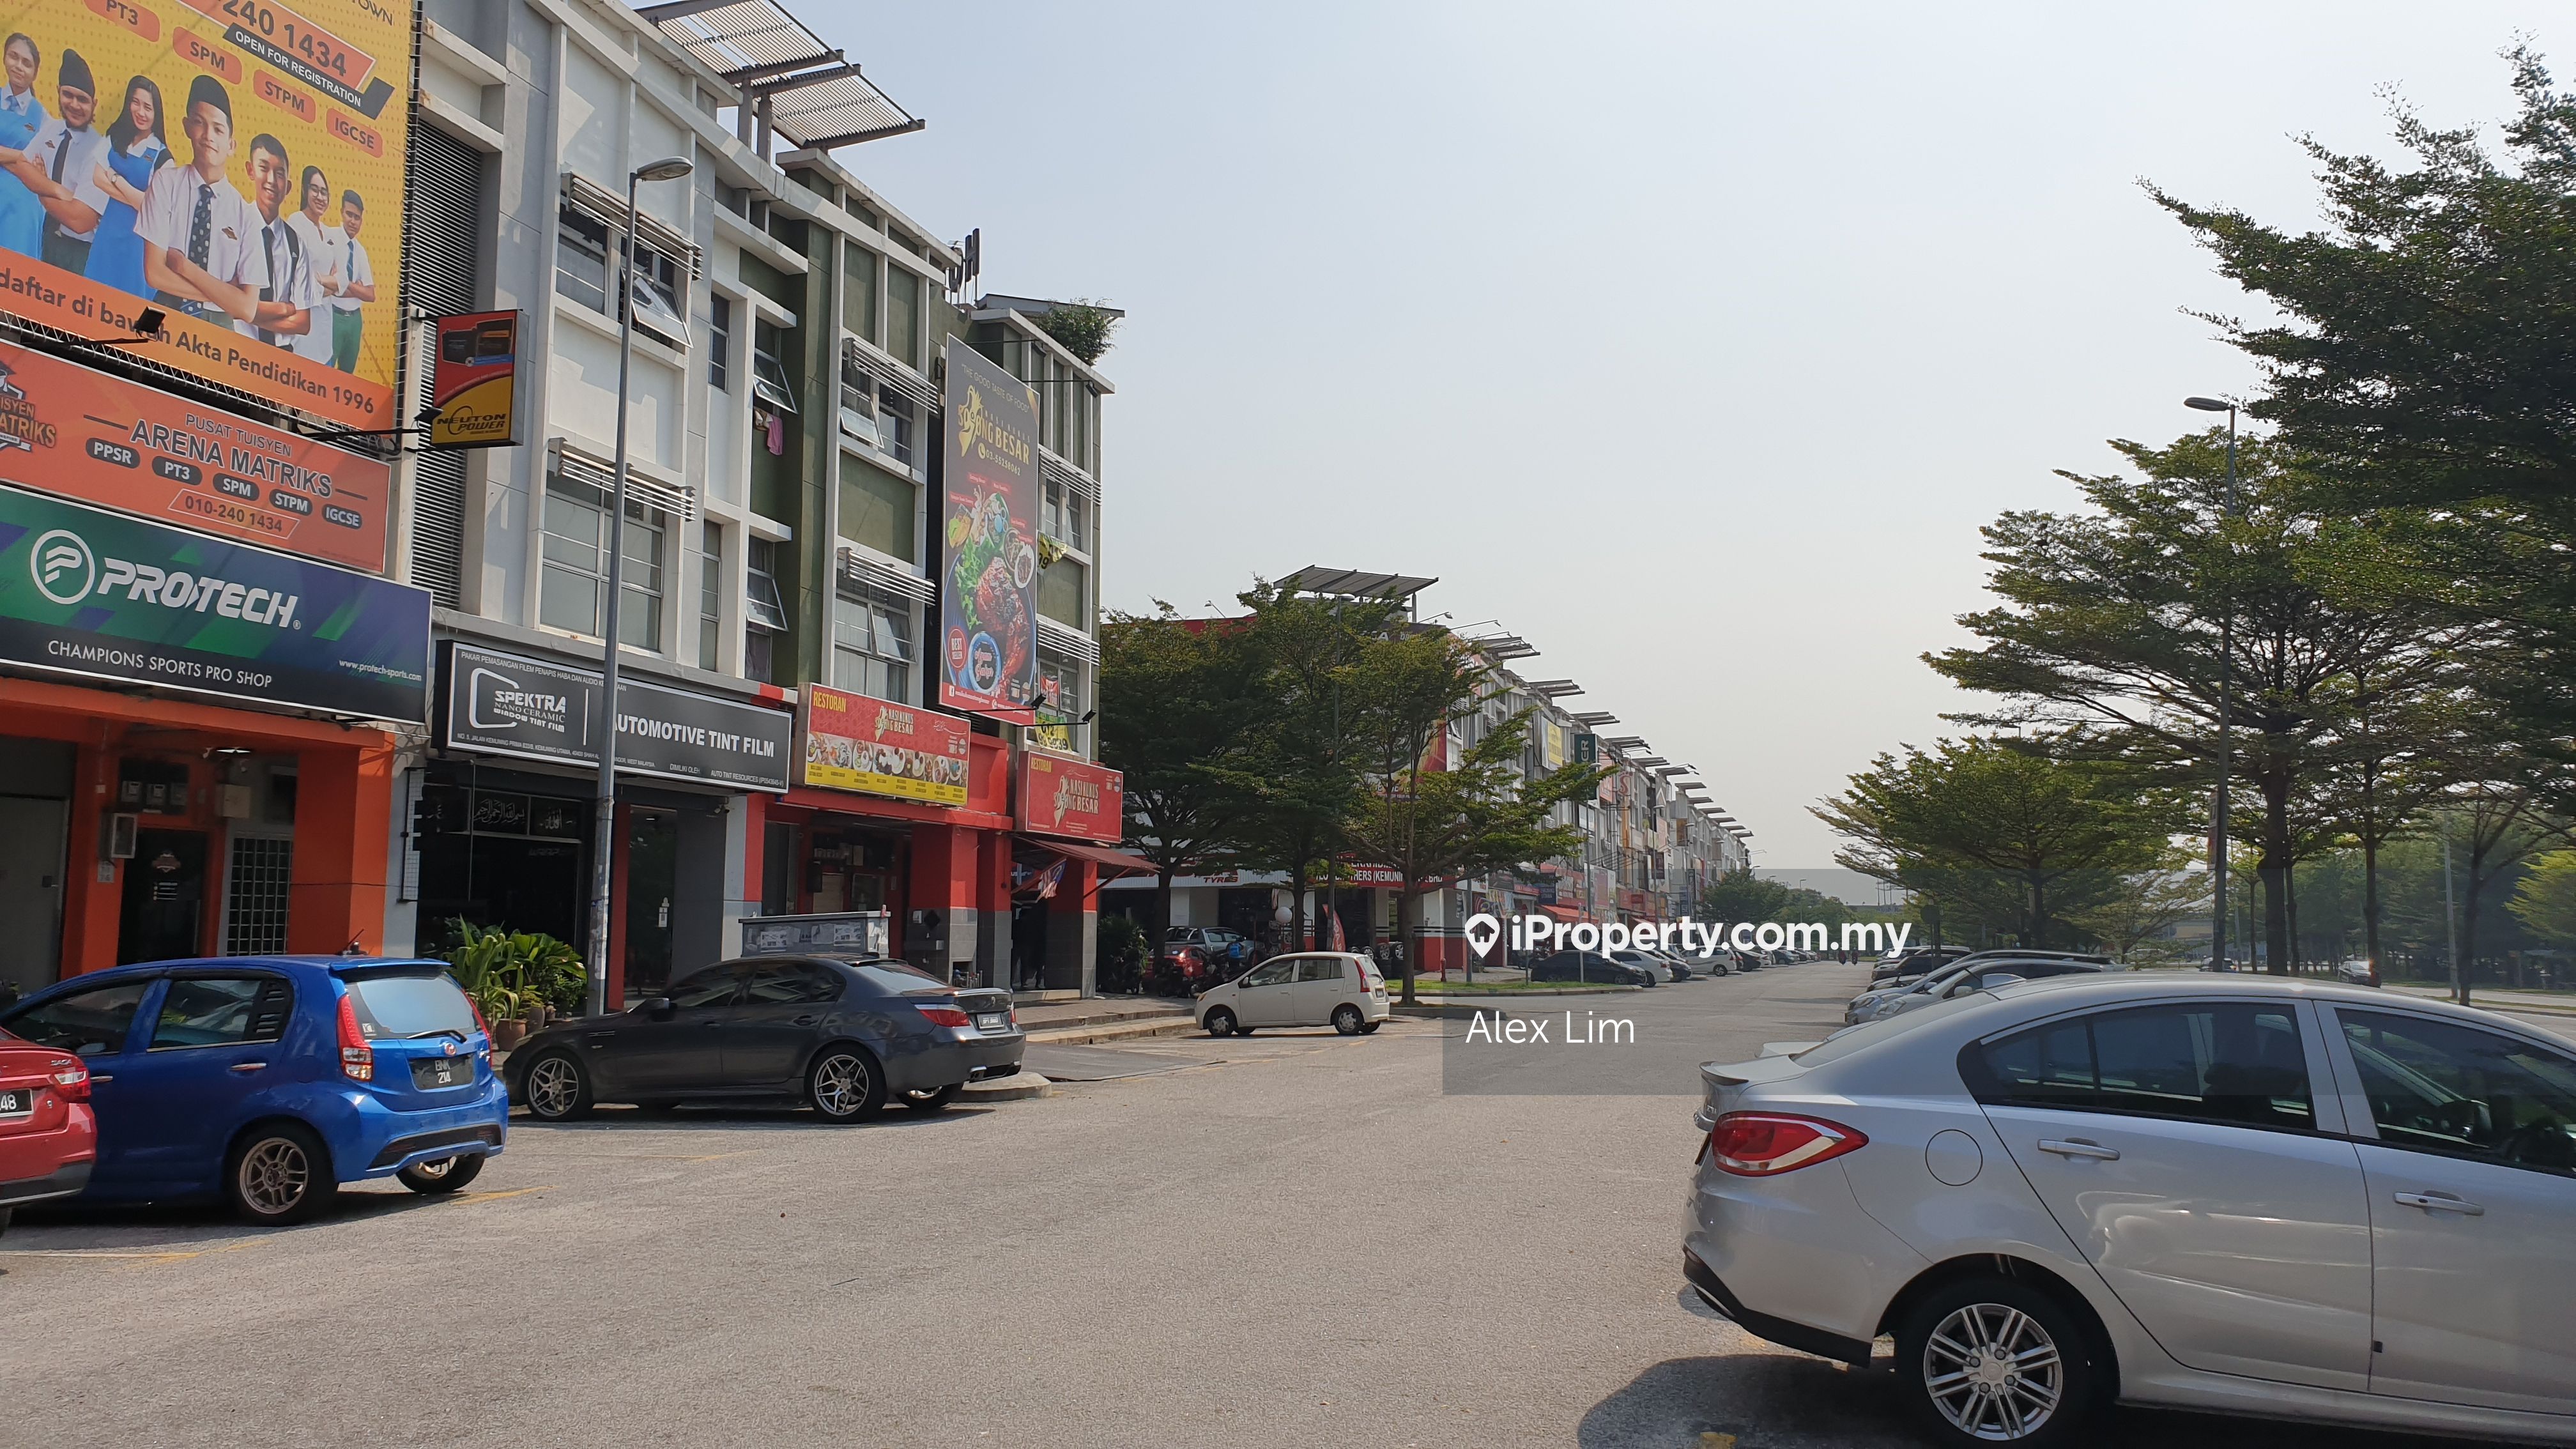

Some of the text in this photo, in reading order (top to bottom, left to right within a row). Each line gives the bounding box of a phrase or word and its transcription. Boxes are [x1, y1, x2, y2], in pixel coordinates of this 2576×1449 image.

[106, 0, 139, 26] PT3
[353, 0, 394, 26] OWN
[190, 41, 225, 71] SPM
[284, 24, 347, 77] 1434
[235, 31, 362, 107] OPEN FOR REGISTRATION
[264, 80, 305, 113] STPM
[334, 117, 375, 150] IGCSE
[72, 295, 93, 318] di
[176, 331, 222, 362] Akta
[227, 348, 327, 398] Pendidikan
[333, 386, 374, 414] 1996
[974, 372, 990, 388] GOOD
[992, 383, 1006, 399] TASTE
[437, 413, 507, 431] NEUTON POWER
[186, 413, 292, 457] PUSAT TUISYEN
[995, 426, 1030, 465] BESAR
[94, 441, 132, 464] PPSR
[130, 418, 332, 498] ARENA MATRIKS
[165, 461, 190, 480] PT3
[223, 478, 251, 497] SPM
[185, 496, 282, 532] 010-240 1434
[275, 493, 308, 512] STPM
[326, 507, 360, 527] IGCSE
[951, 638, 963, 650] BEST
[47, 640, 272, 688] CHAMPIONS SPORTS PRO SHOP
[339, 660, 422, 682] www.protech-sports.com
[461, 651, 480, 662] PAKAR
[481, 656, 519, 670] PEMASANGAN
[519, 664, 534, 673] FILEM
[535, 666, 556, 678] PENAPIS
[556, 671, 571, 680] HABA
[571, 675, 582, 683] DAN
[582, 676, 597, 686] AUDIO
[494, 690, 567, 714] SPEKTRA
[494, 702, 566, 723] NANO CERAMIC
[813, 691, 847, 713] RESTORAN
[493, 708, 528, 722] WINDOW
[548, 722, 565, 733] FILM
[895, 721, 914, 735] BESAR
[709, 730, 740, 751] TINT
[743, 737, 775, 758] FILM
[1031, 757, 1052, 773] RESTORAN
[1070, 779, 1082, 796] NASI
[1083, 781, 1099, 799] KUKUS
[1077, 797, 1099, 815] BESAR
[437, 1071, 452, 1084] 214
